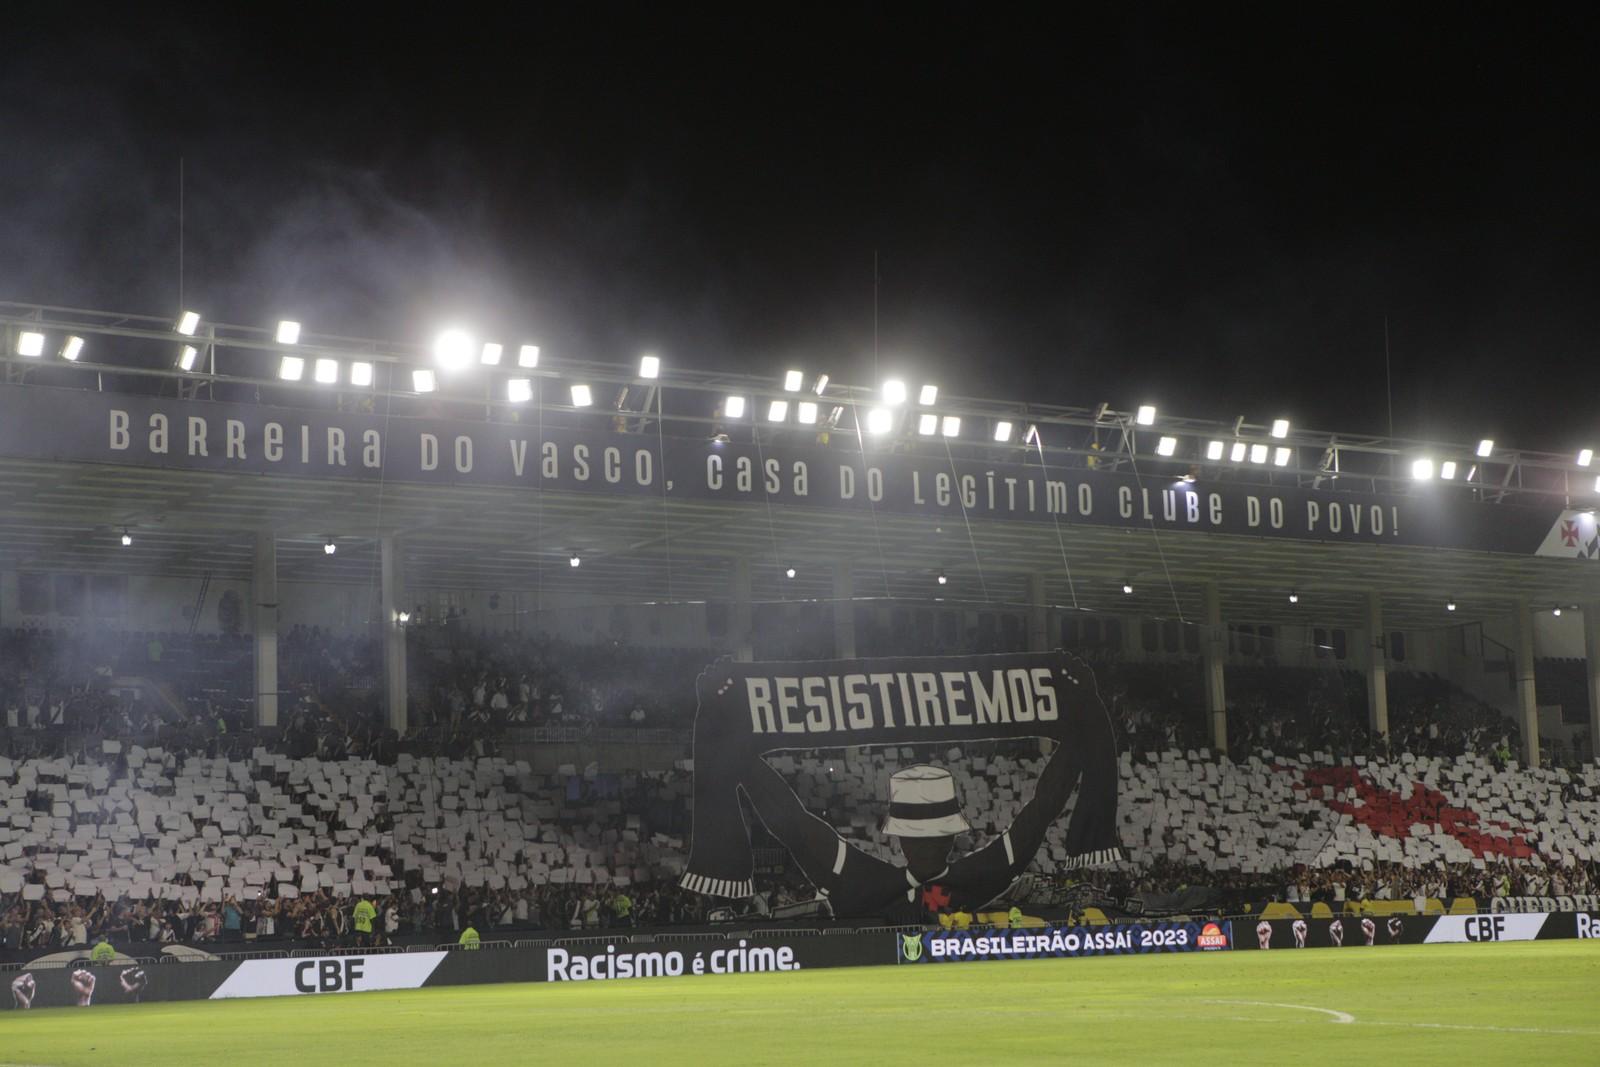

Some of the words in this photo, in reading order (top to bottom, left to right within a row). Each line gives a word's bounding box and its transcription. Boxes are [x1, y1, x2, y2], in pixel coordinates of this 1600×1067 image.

[745, 668, 1059, 733] RESISTIREMOS
[931, 930, 1080, 957] BRASILEIRÃO
[1084, 930, 1132, 951] ASSAÍ
[1141, 928, 1188, 947] 2023
[1465, 916, 1505, 941] CBF
[294, 958, 365, 993] CBF
[547, 945, 683, 982] Racismo
[692, 952, 704, 975] é
[710, 939, 800, 974] crime.
